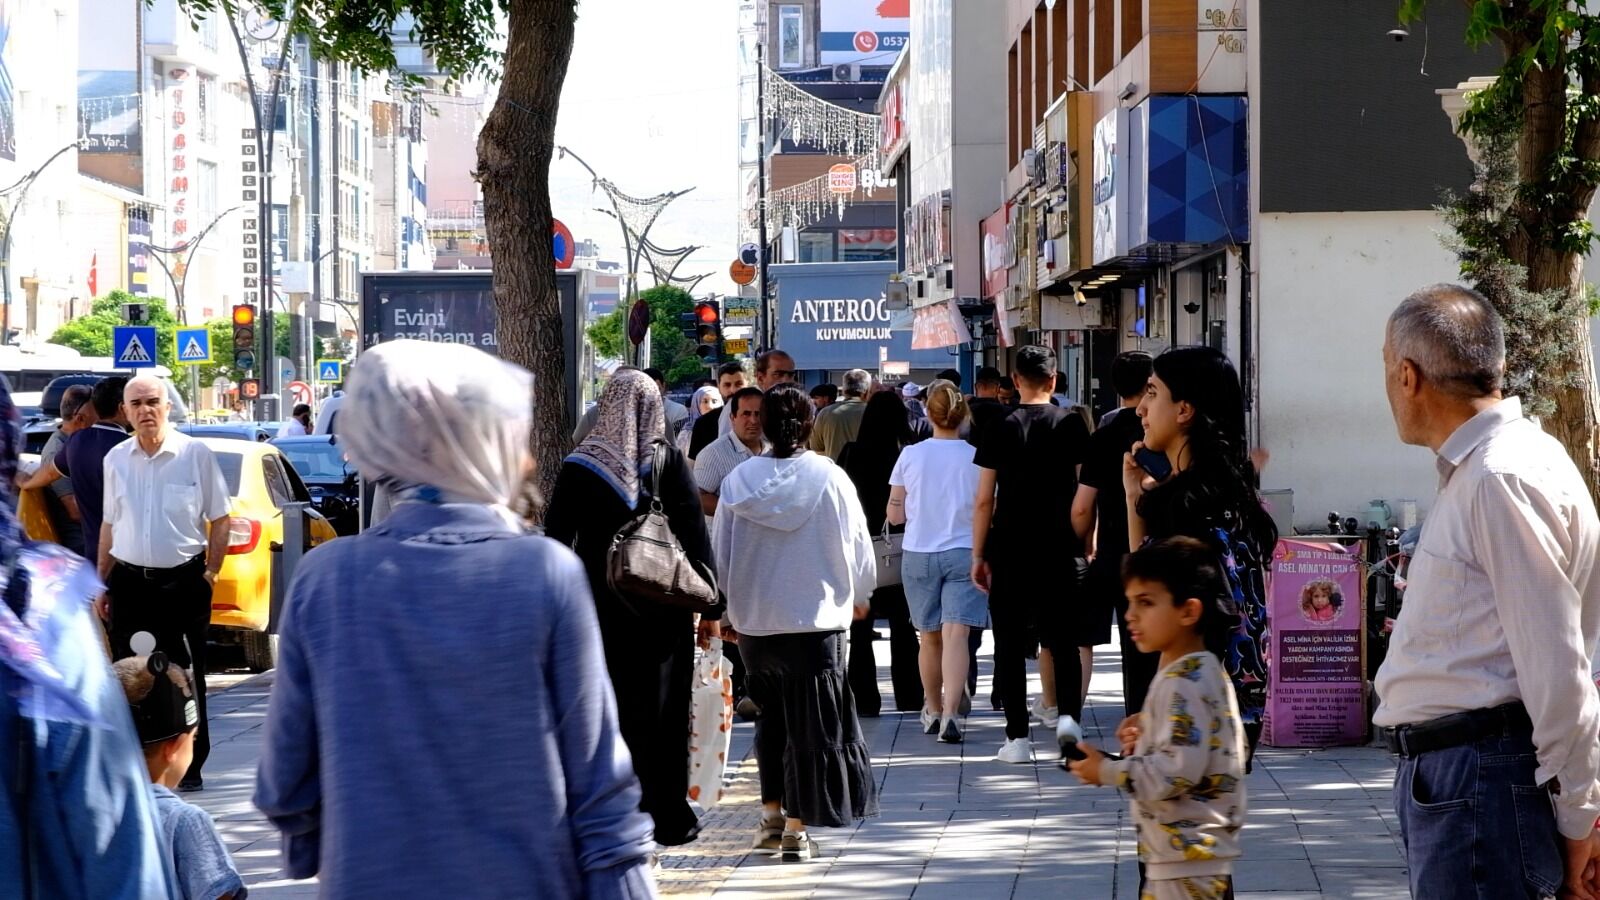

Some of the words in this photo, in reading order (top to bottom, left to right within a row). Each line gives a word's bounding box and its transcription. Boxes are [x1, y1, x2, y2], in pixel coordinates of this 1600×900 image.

[244, 129, 255, 200] HOTEL
[862, 169, 897, 187] BU
[394, 308, 445, 326] Evini
[816, 327, 892, 340] KUYUMCULUK
[1278, 562, 1296, 573] ASEL
[1333, 564, 1347, 573] CAN
